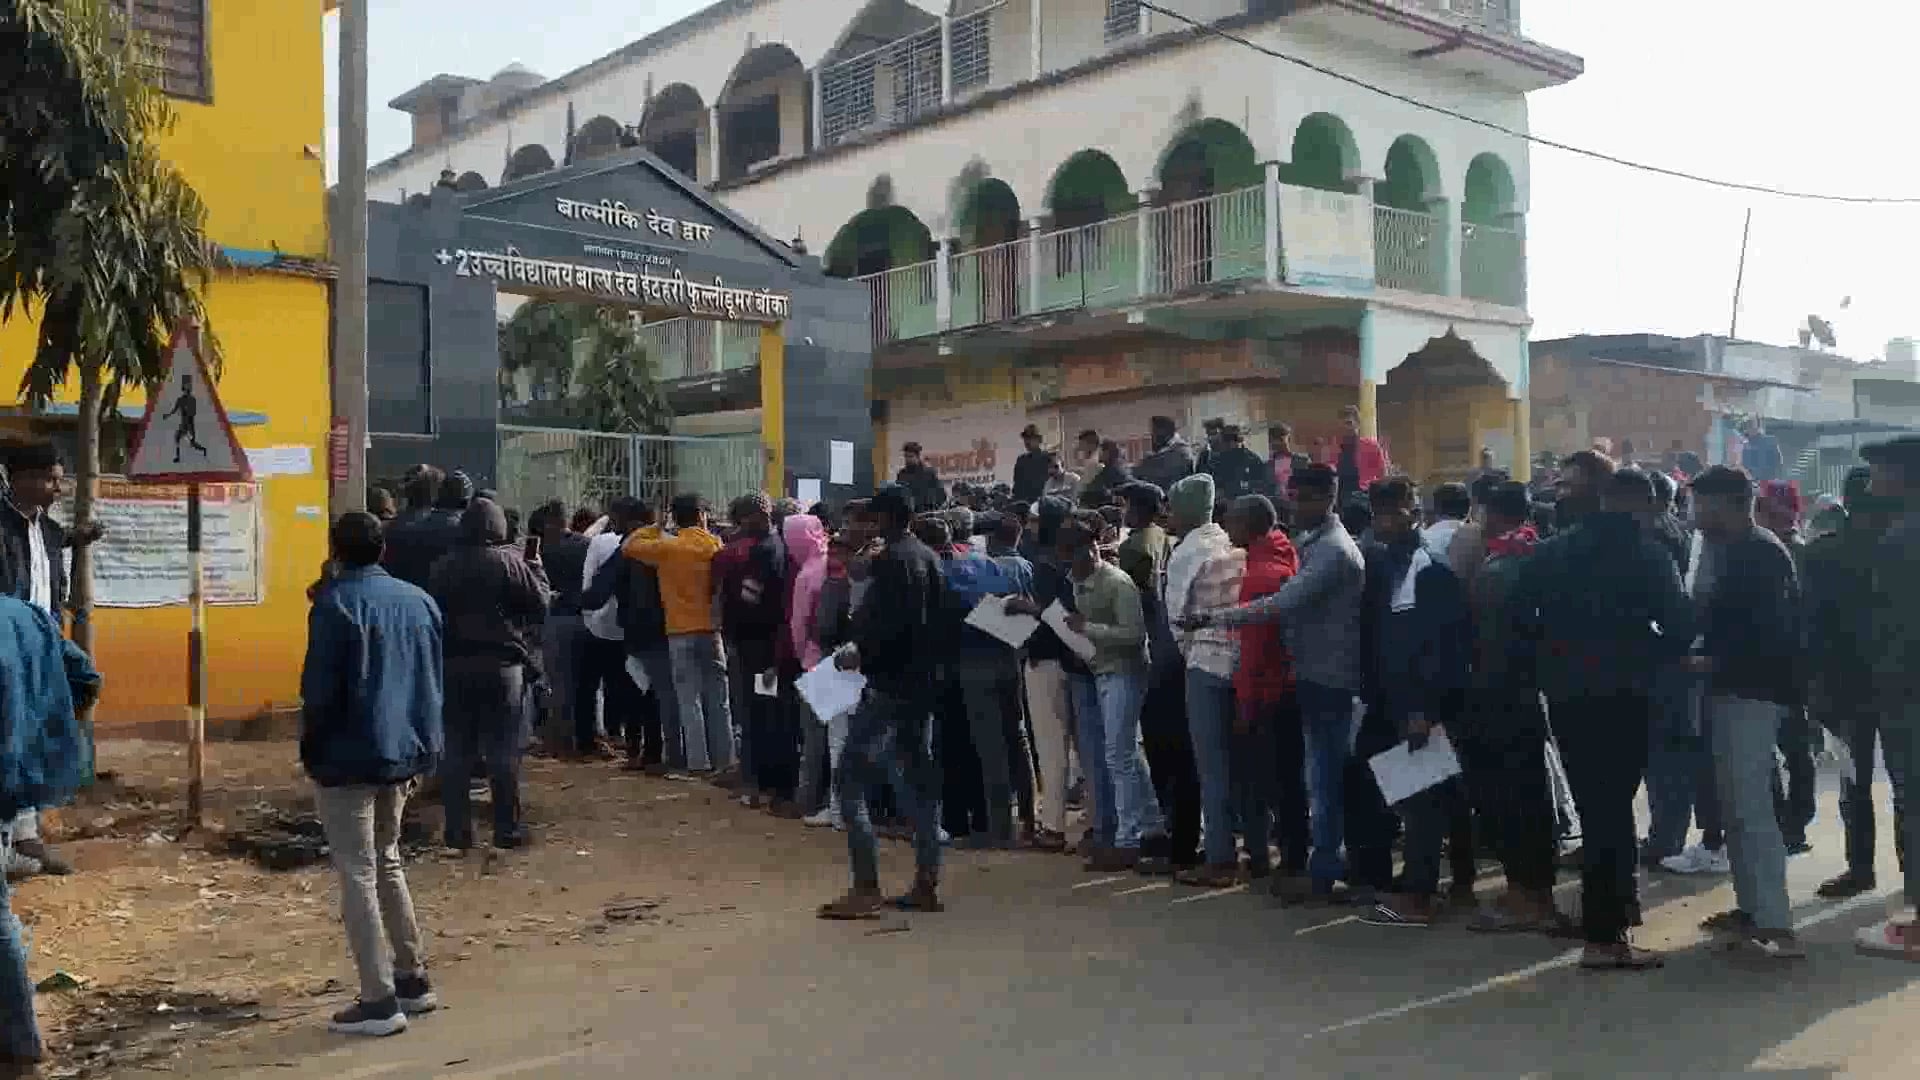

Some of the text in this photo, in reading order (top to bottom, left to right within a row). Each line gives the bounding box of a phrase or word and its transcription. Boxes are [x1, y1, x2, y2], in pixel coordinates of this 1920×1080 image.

[556, 197, 714, 242] बाल्मीकि देव द्वार
[614, 261, 638, 297] देव
